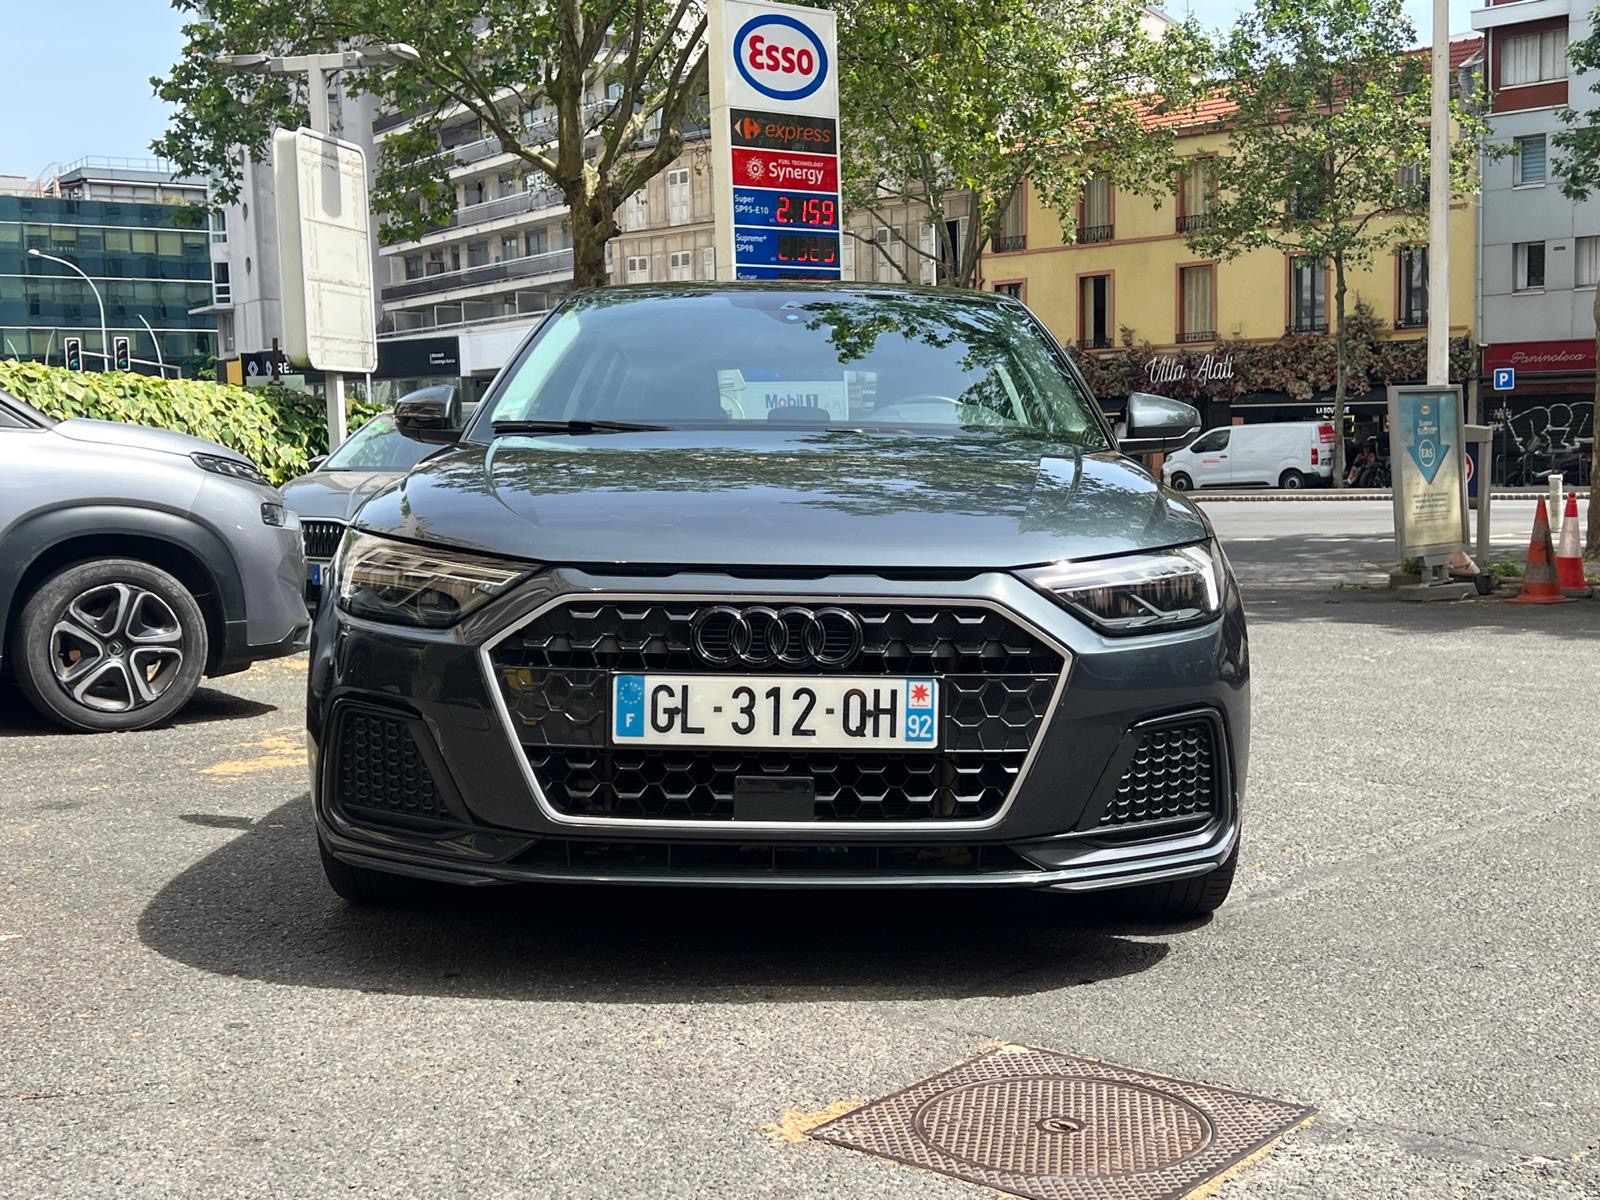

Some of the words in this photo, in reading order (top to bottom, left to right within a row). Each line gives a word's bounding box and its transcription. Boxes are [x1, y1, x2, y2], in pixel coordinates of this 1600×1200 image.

[765, 124, 831, 143] express
[792, 160, 824, 168] TECHNOLOGY
[769, 162, 824, 184] Synergy
[734, 194, 755, 204] Super
[734, 205, 769, 214] SP95-E10
[776, 196, 834, 225] 2.159
[736, 244, 754, 252] SP98
[1144, 355, 1186, 384] Villa
[1196, 352, 1235, 386] Alati
[1500, 372, 1509, 386] P
[1316, 406, 1323, 414] LA
[1421, 448, 1433, 458] E85
[650, 684, 898, 738] GL-312-QH
[626, 713, 635, 728] F
[908, 714, 932, 738] 92
